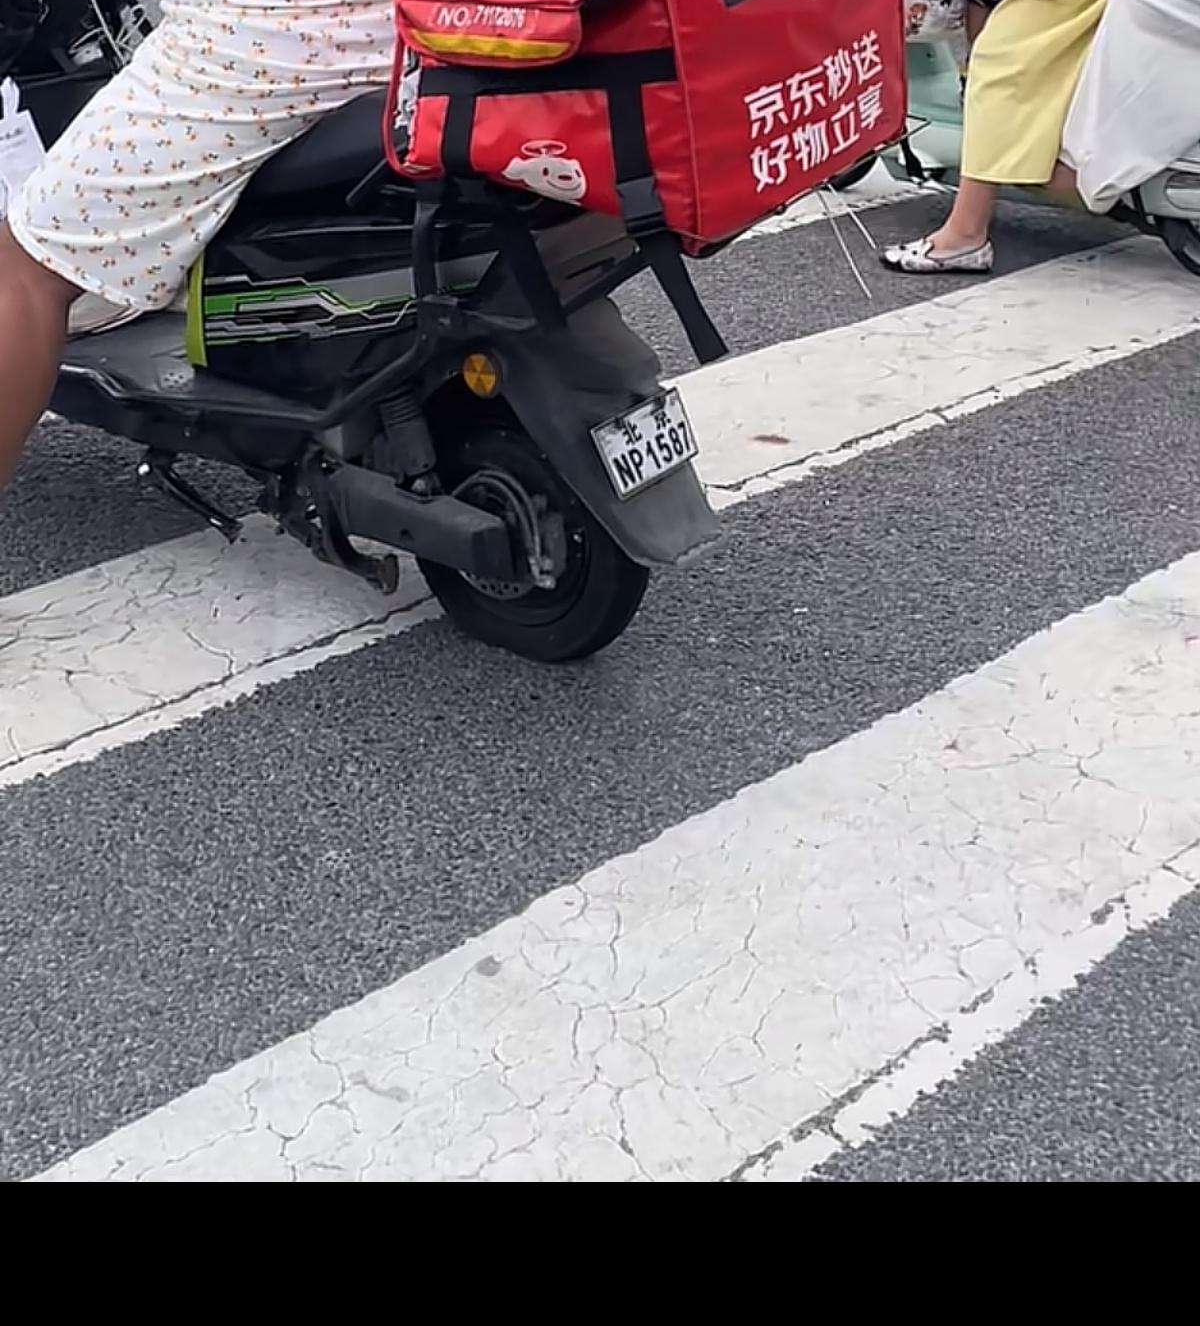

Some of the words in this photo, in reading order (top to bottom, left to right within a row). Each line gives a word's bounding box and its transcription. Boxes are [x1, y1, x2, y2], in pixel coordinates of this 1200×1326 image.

[744, 29, 882, 140] 京东秒送
[750, 82, 883, 193] 好物立享
[613, 421, 692, 489] NP1587
